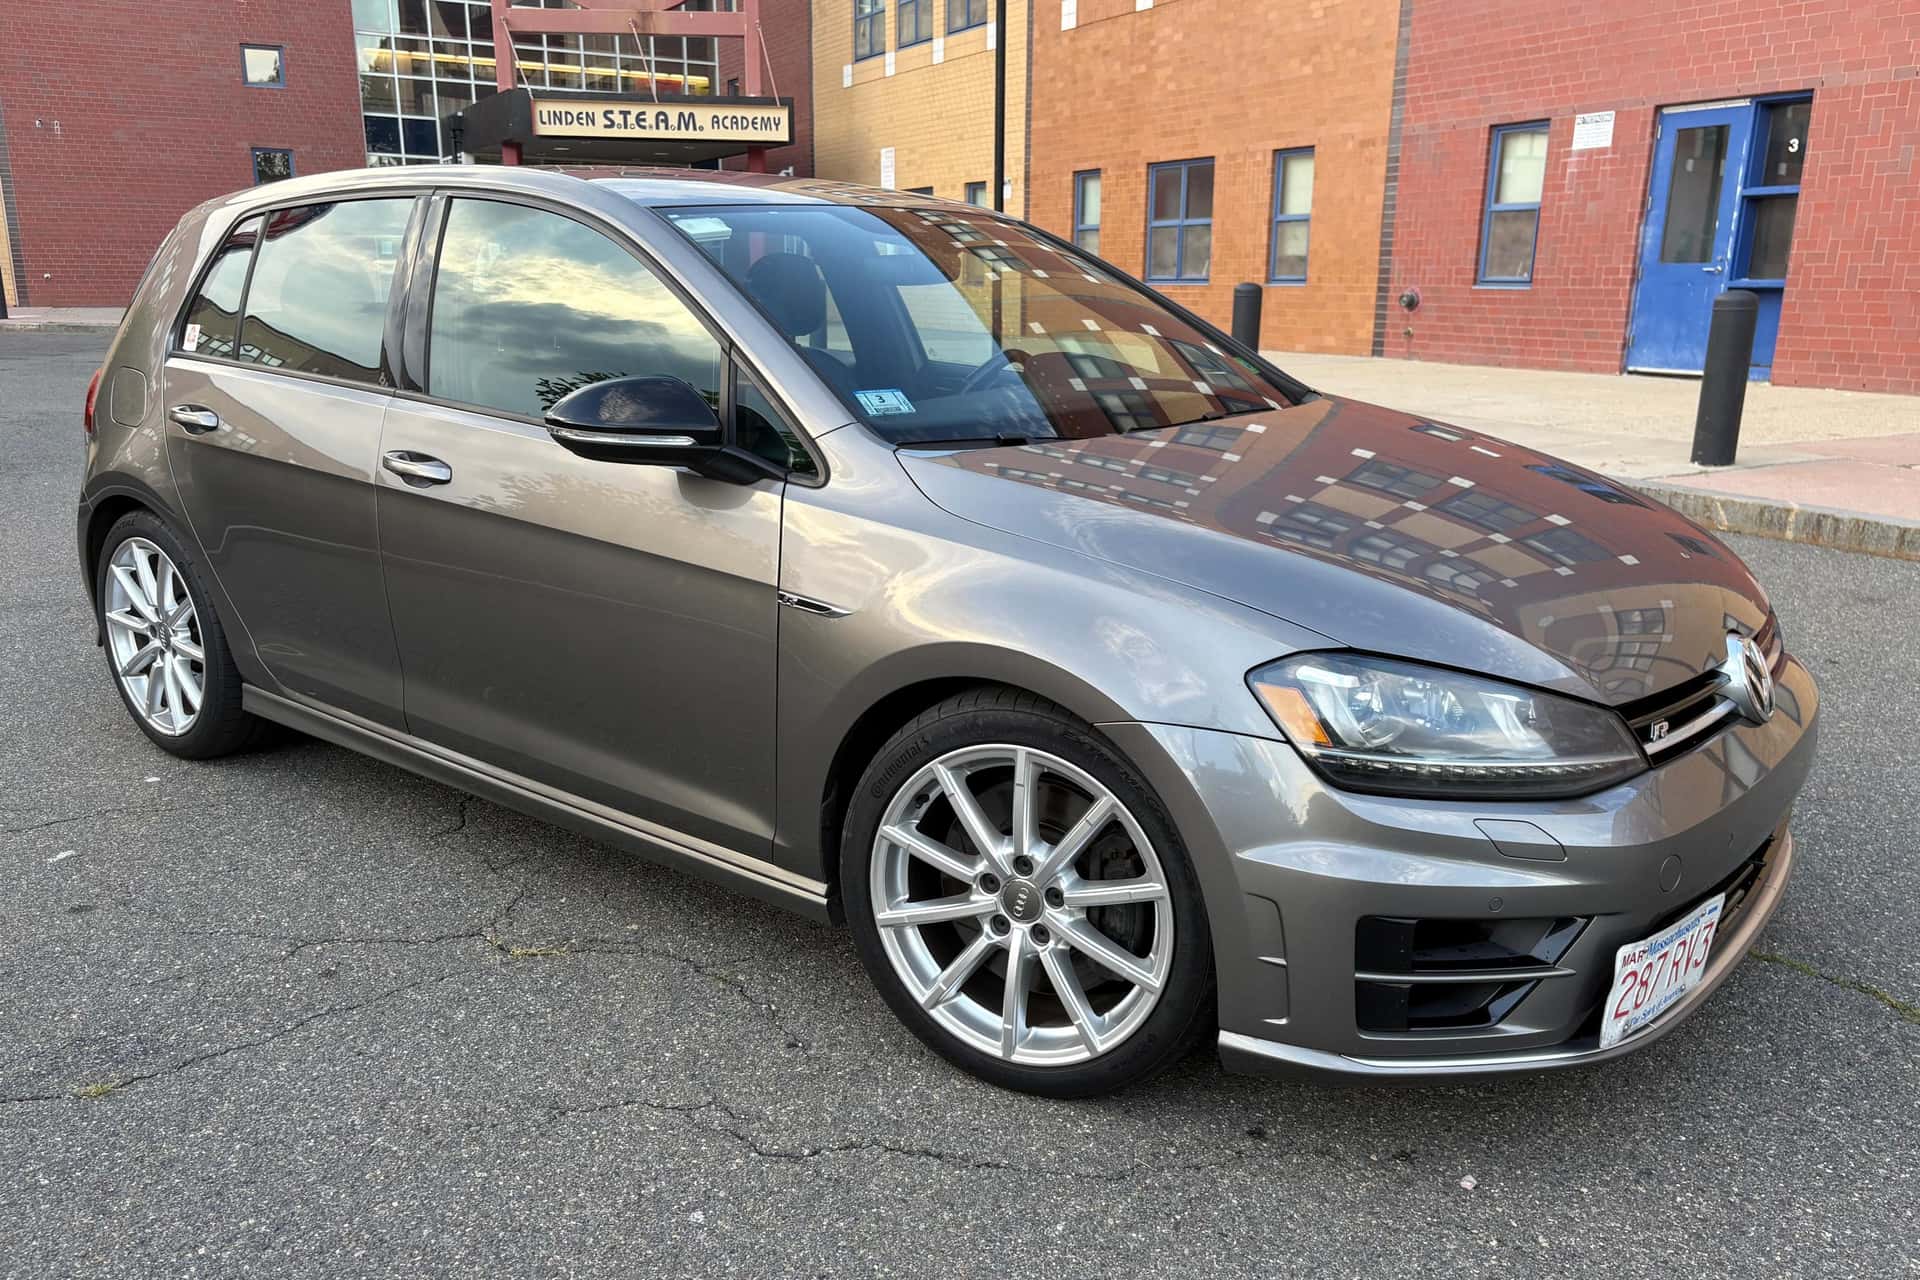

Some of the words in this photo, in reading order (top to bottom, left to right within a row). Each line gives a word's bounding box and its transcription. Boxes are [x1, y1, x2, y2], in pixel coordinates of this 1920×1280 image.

[539, 110, 596, 127] LINDEN
[603, 109, 704, 132] S.T.E.A.M.
[711, 114, 781, 131] ACADEMY
[1788, 137, 1800, 153] 3
[875, 395, 886, 403] 3
[1622, 949, 1646, 969] MAR
[1613, 951, 1668, 1020] 287
[1667, 921, 1714, 988] RV3
